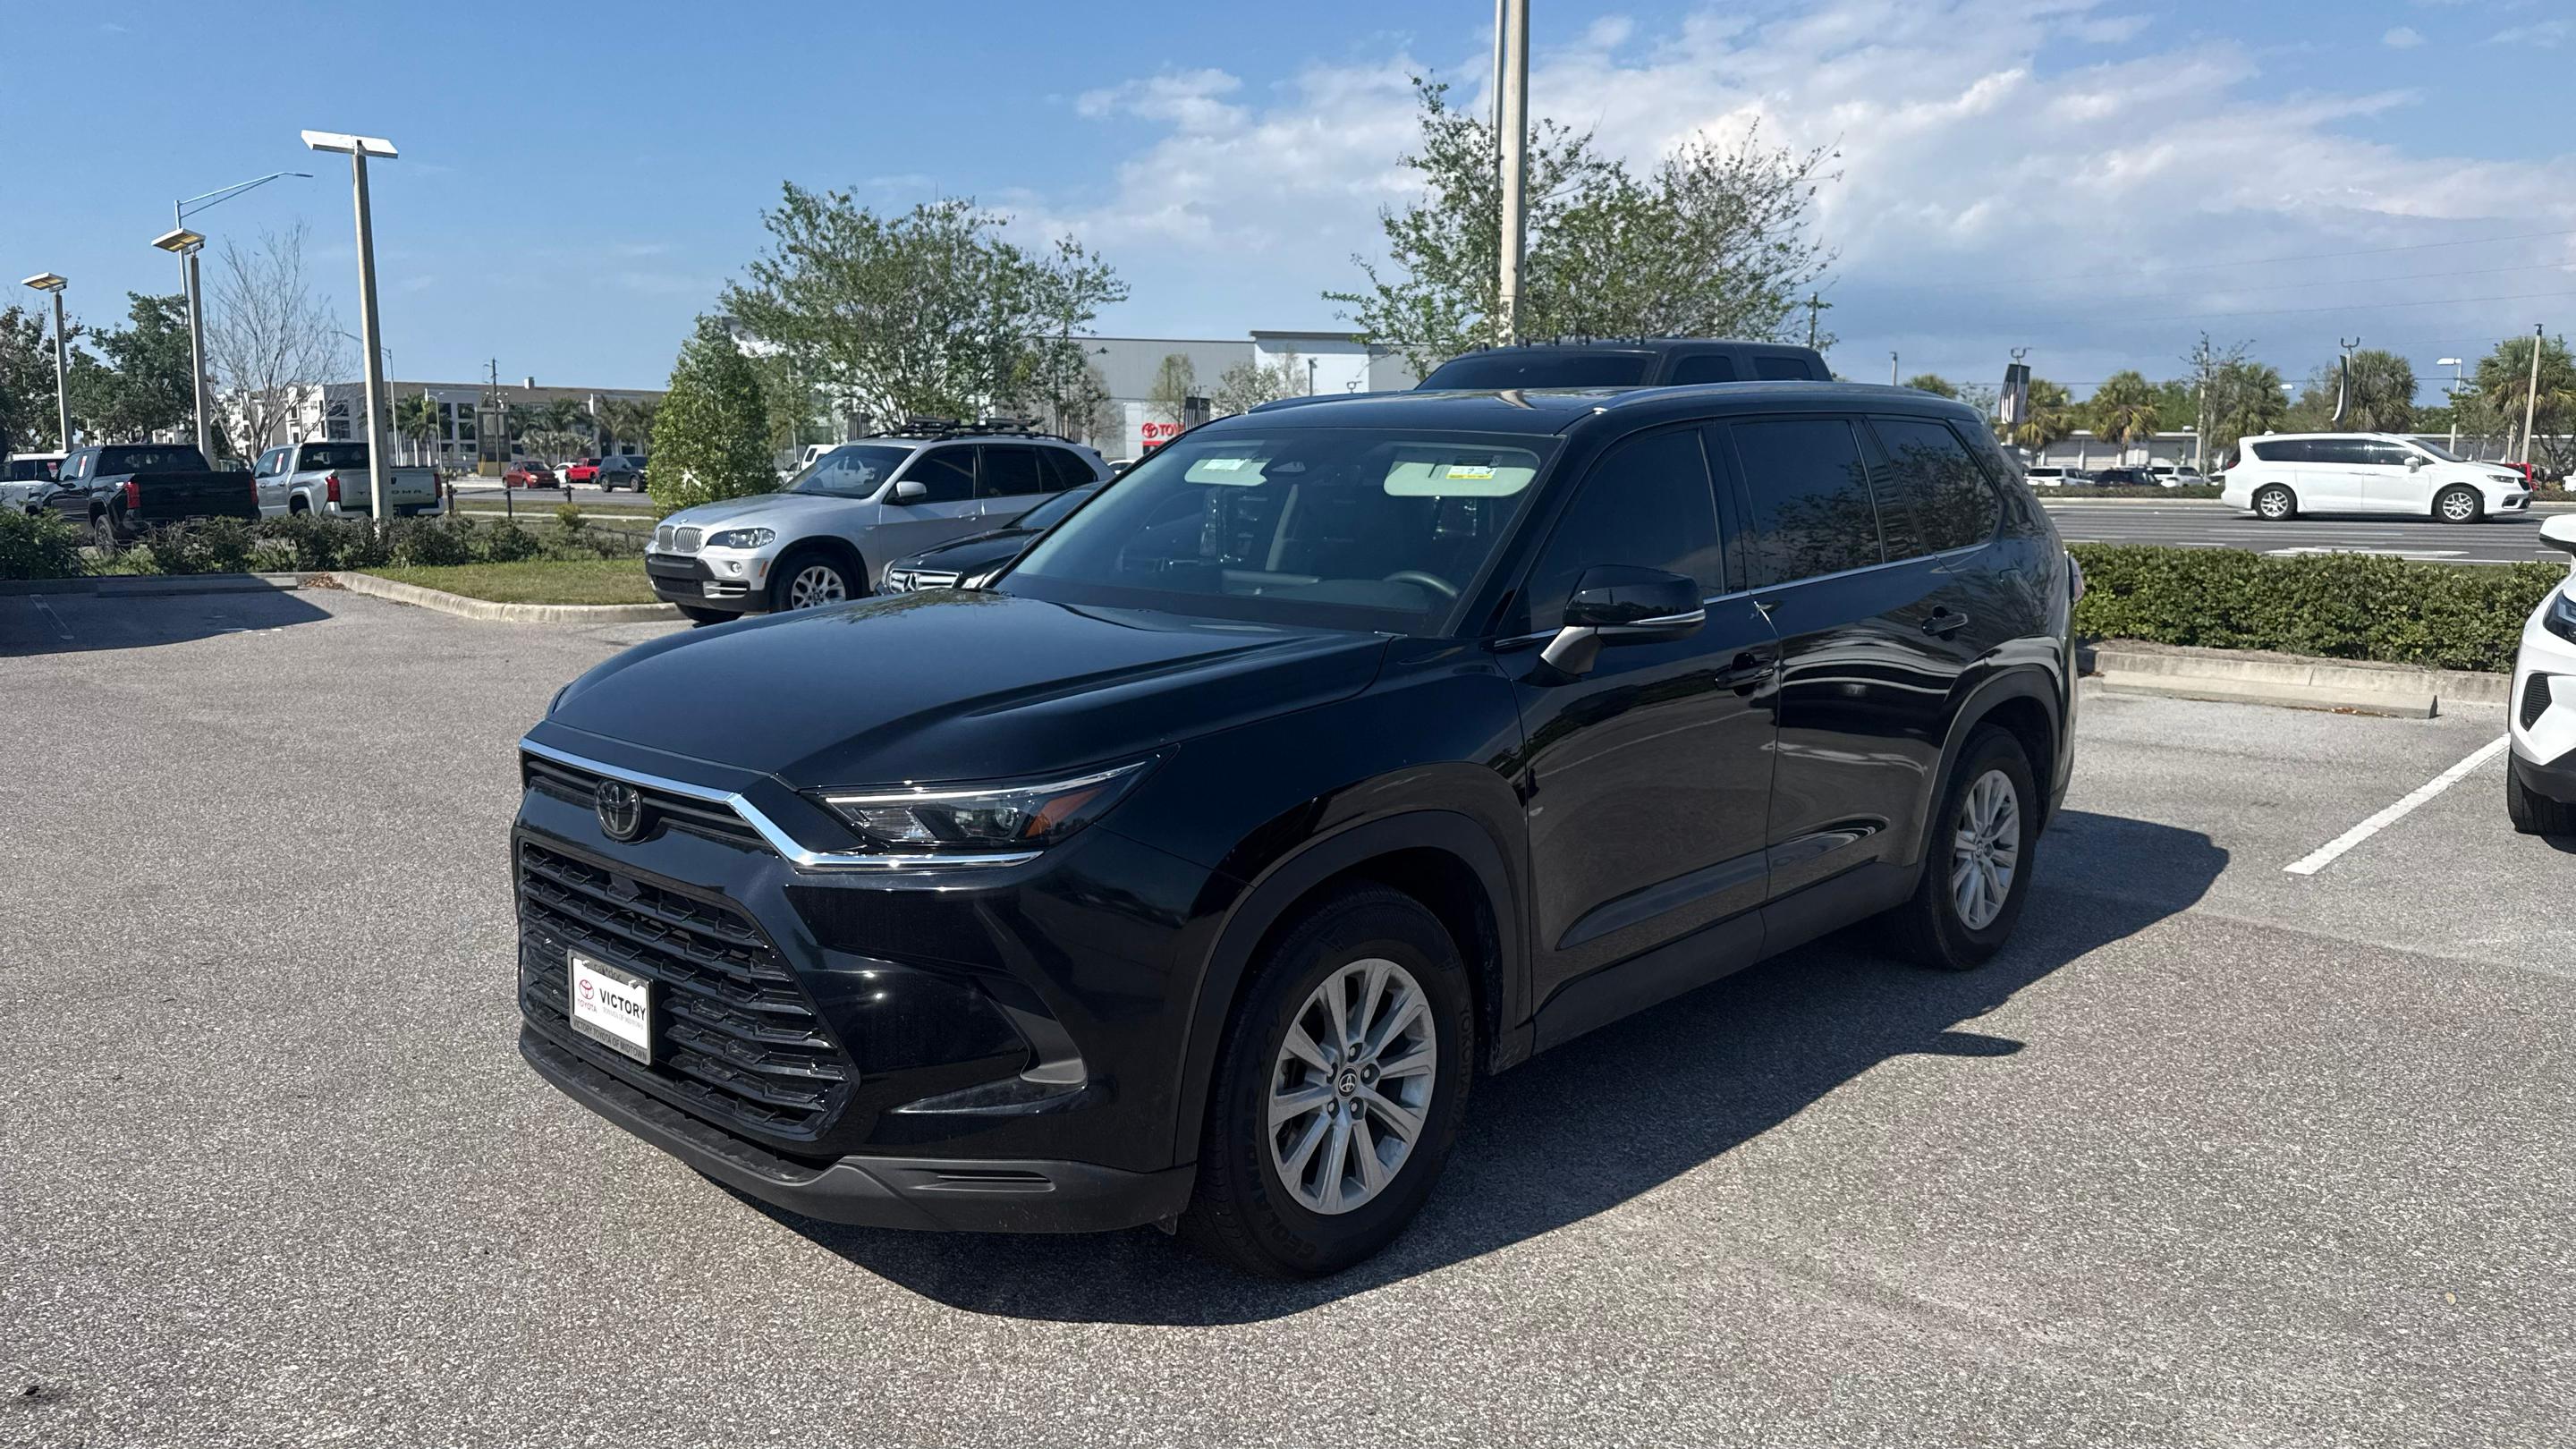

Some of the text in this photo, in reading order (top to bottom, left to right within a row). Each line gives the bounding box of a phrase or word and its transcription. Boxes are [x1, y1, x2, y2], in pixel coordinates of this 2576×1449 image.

[577, 998, 597, 1013] TOYOTA
[599, 988, 646, 1021] VICTORY
[573, 1018, 647, 1061] VICTORY TOYOTA OF MIDTOWN
